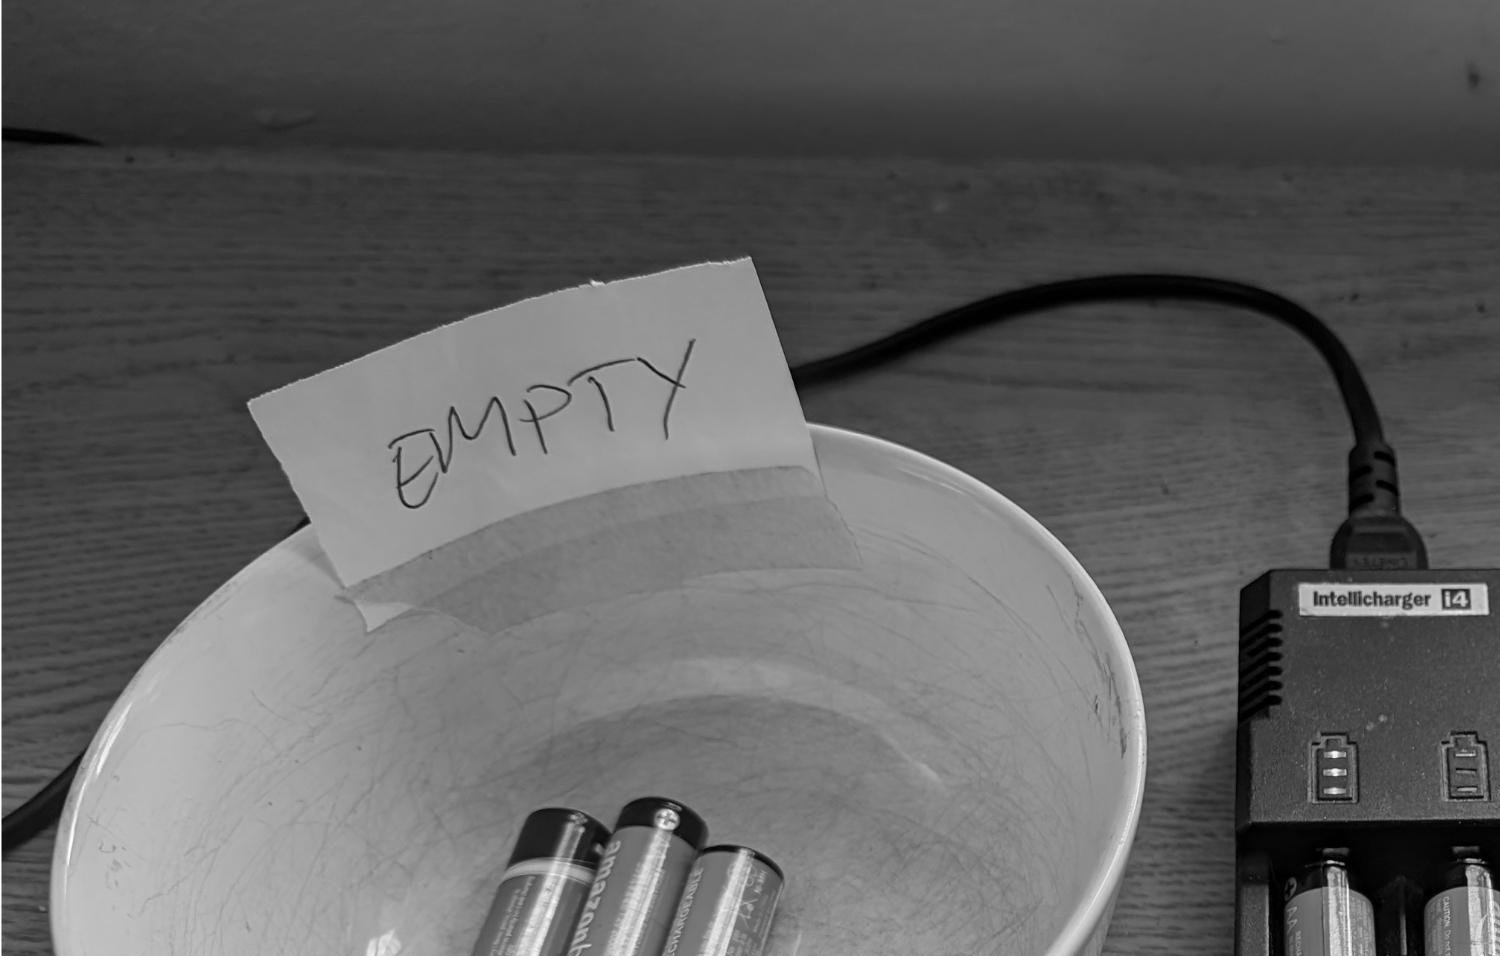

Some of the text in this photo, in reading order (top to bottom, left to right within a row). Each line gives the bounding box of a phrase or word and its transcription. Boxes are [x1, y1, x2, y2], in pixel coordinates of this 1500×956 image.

[388, 338, 696, 509] EMPTY
[1312, 589, 1432, 611] Intellicharger
[1285, 906, 1297, 934] AA
[1444, 929, 1451, 939] Do
